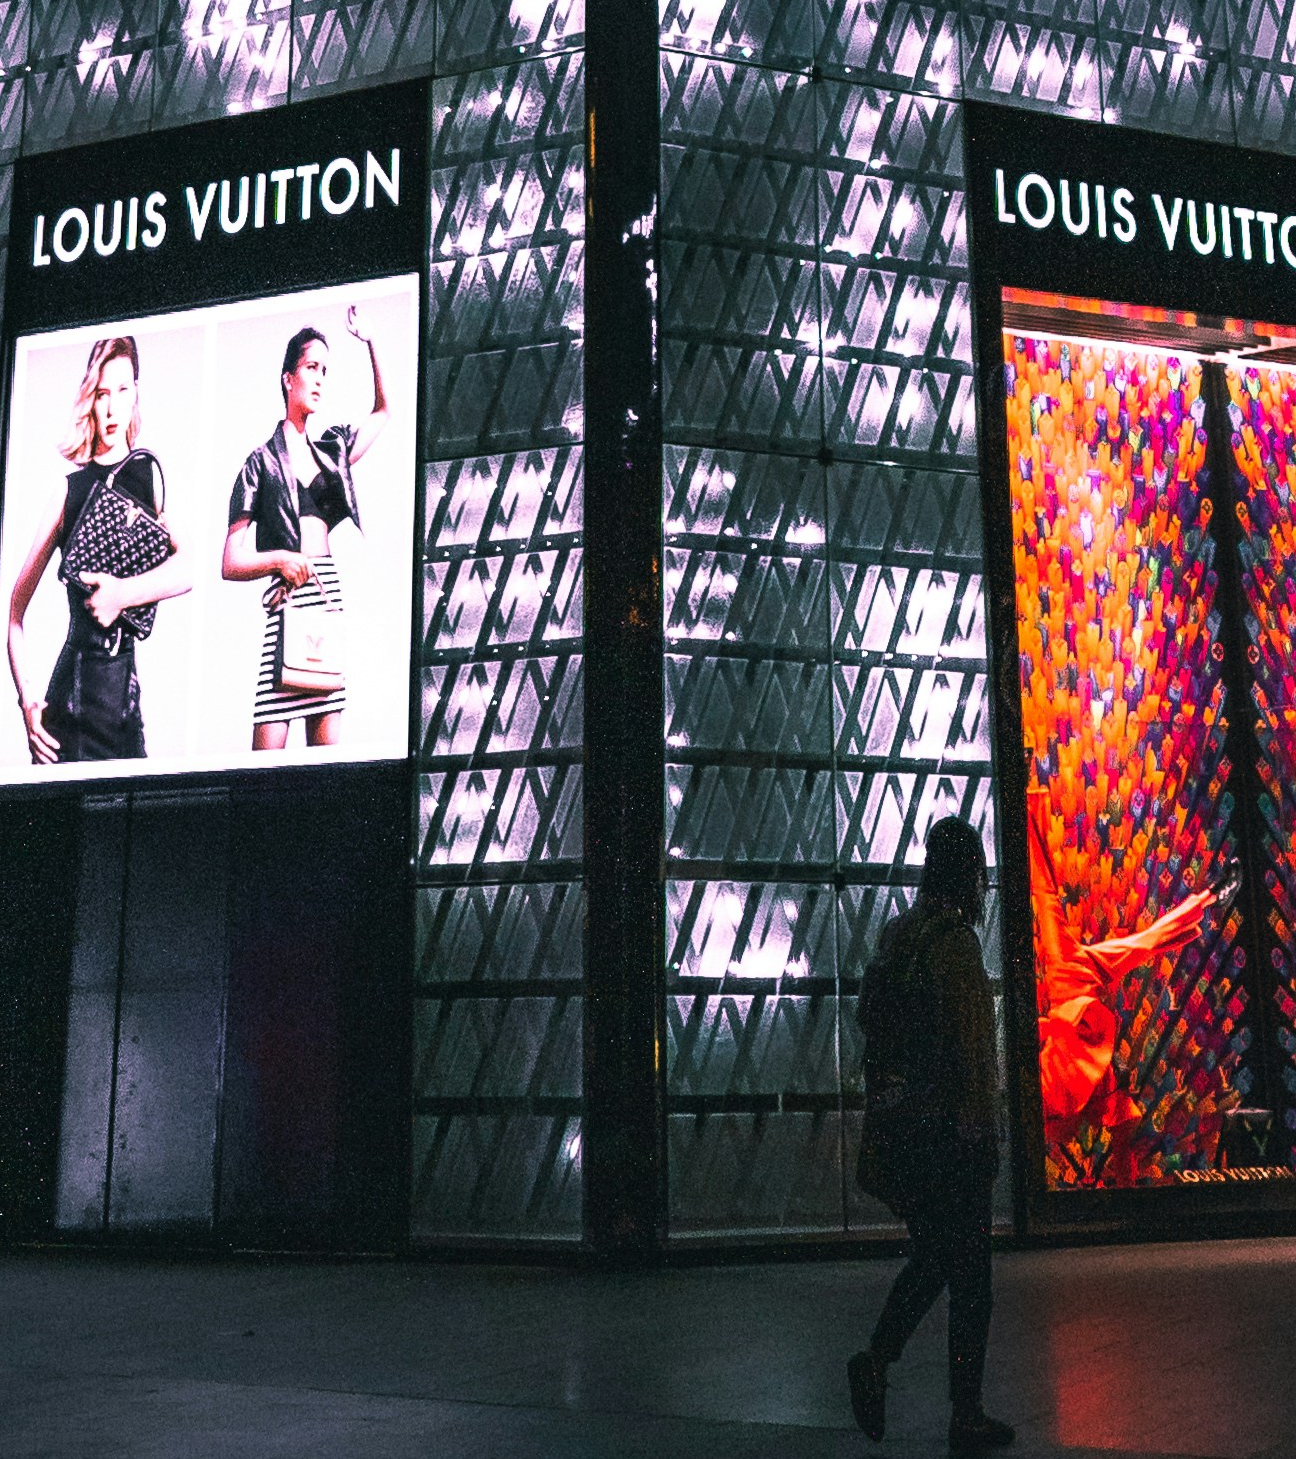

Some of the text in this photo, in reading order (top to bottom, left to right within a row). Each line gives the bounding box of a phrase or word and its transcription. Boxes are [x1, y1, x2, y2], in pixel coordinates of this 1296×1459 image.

[30, 147, 402, 269] LOUIS VUITTON
[994, 167, 1138, 244] LOUIS
